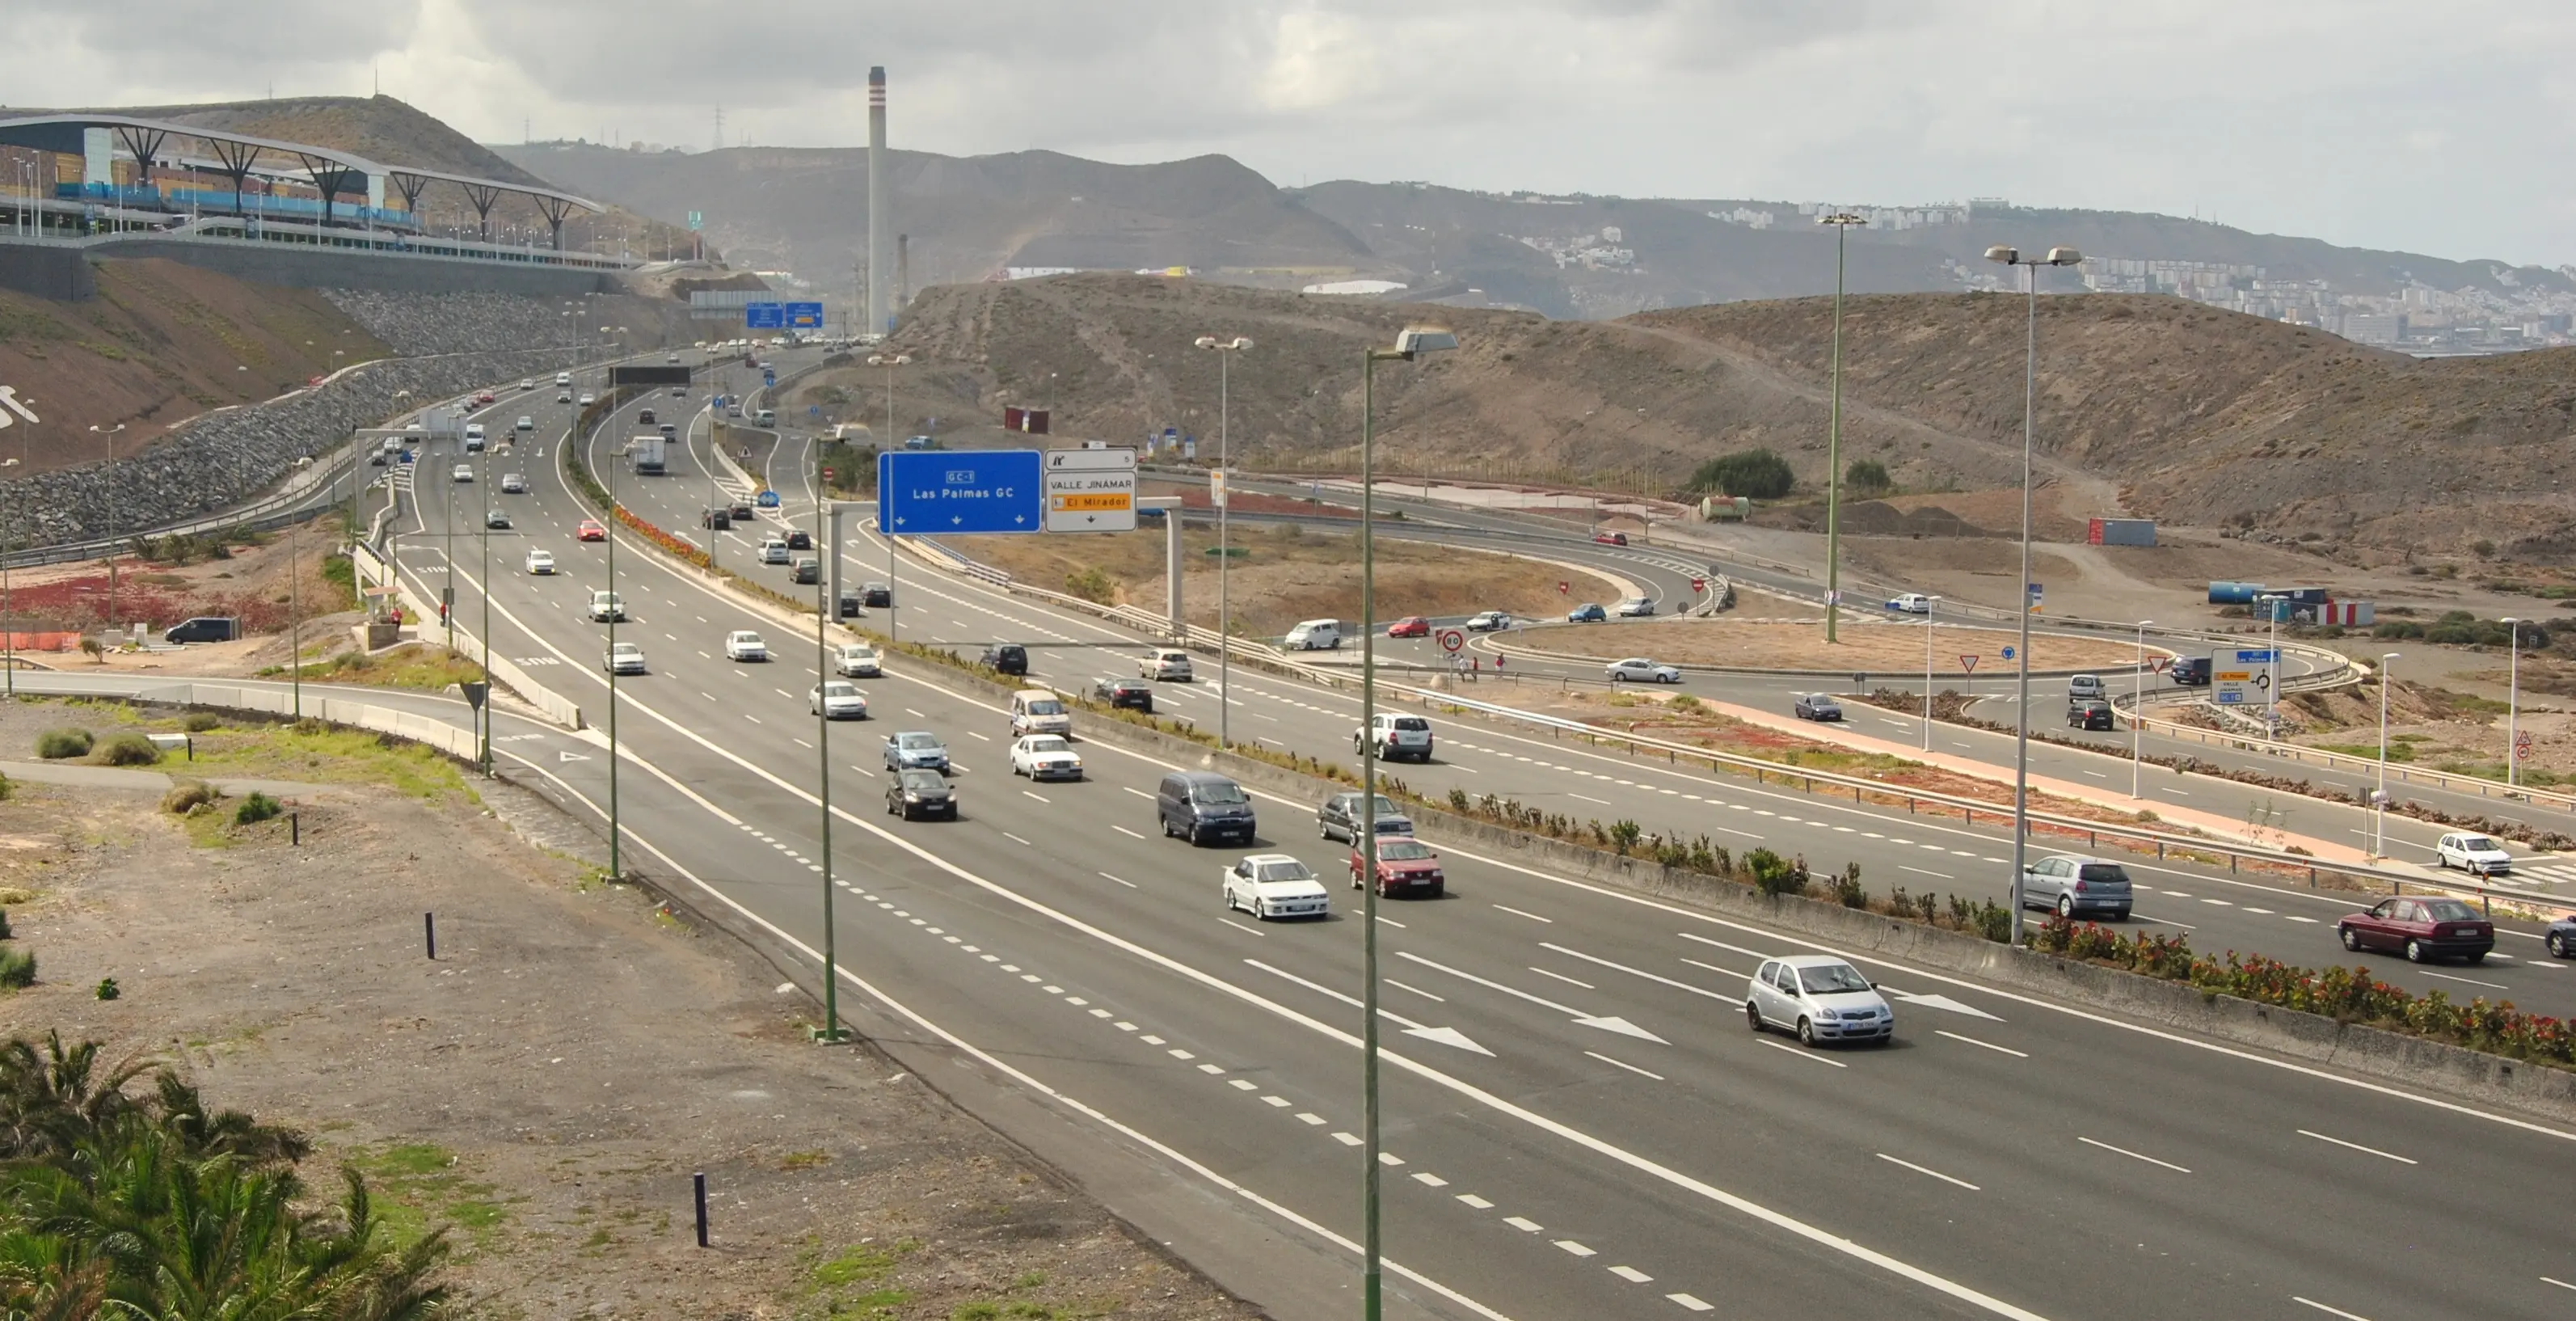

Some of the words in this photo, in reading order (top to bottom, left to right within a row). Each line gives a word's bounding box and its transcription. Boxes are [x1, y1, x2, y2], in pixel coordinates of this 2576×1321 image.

[1124, 455, 1130, 463] 5
[948, 472, 972, 482] GC-1
[1051, 480, 1082, 489] VALLE
[1087, 479, 1132, 489] JINÁMAR
[913, 489, 936, 499] Las
[942, 488, 989, 499] Palmas
[996, 487, 1014, 498] GC
[1067, 498, 1077, 507] El
[1084, 497, 1127, 507] Mirador
[1447, 637, 1459, 645] 80
